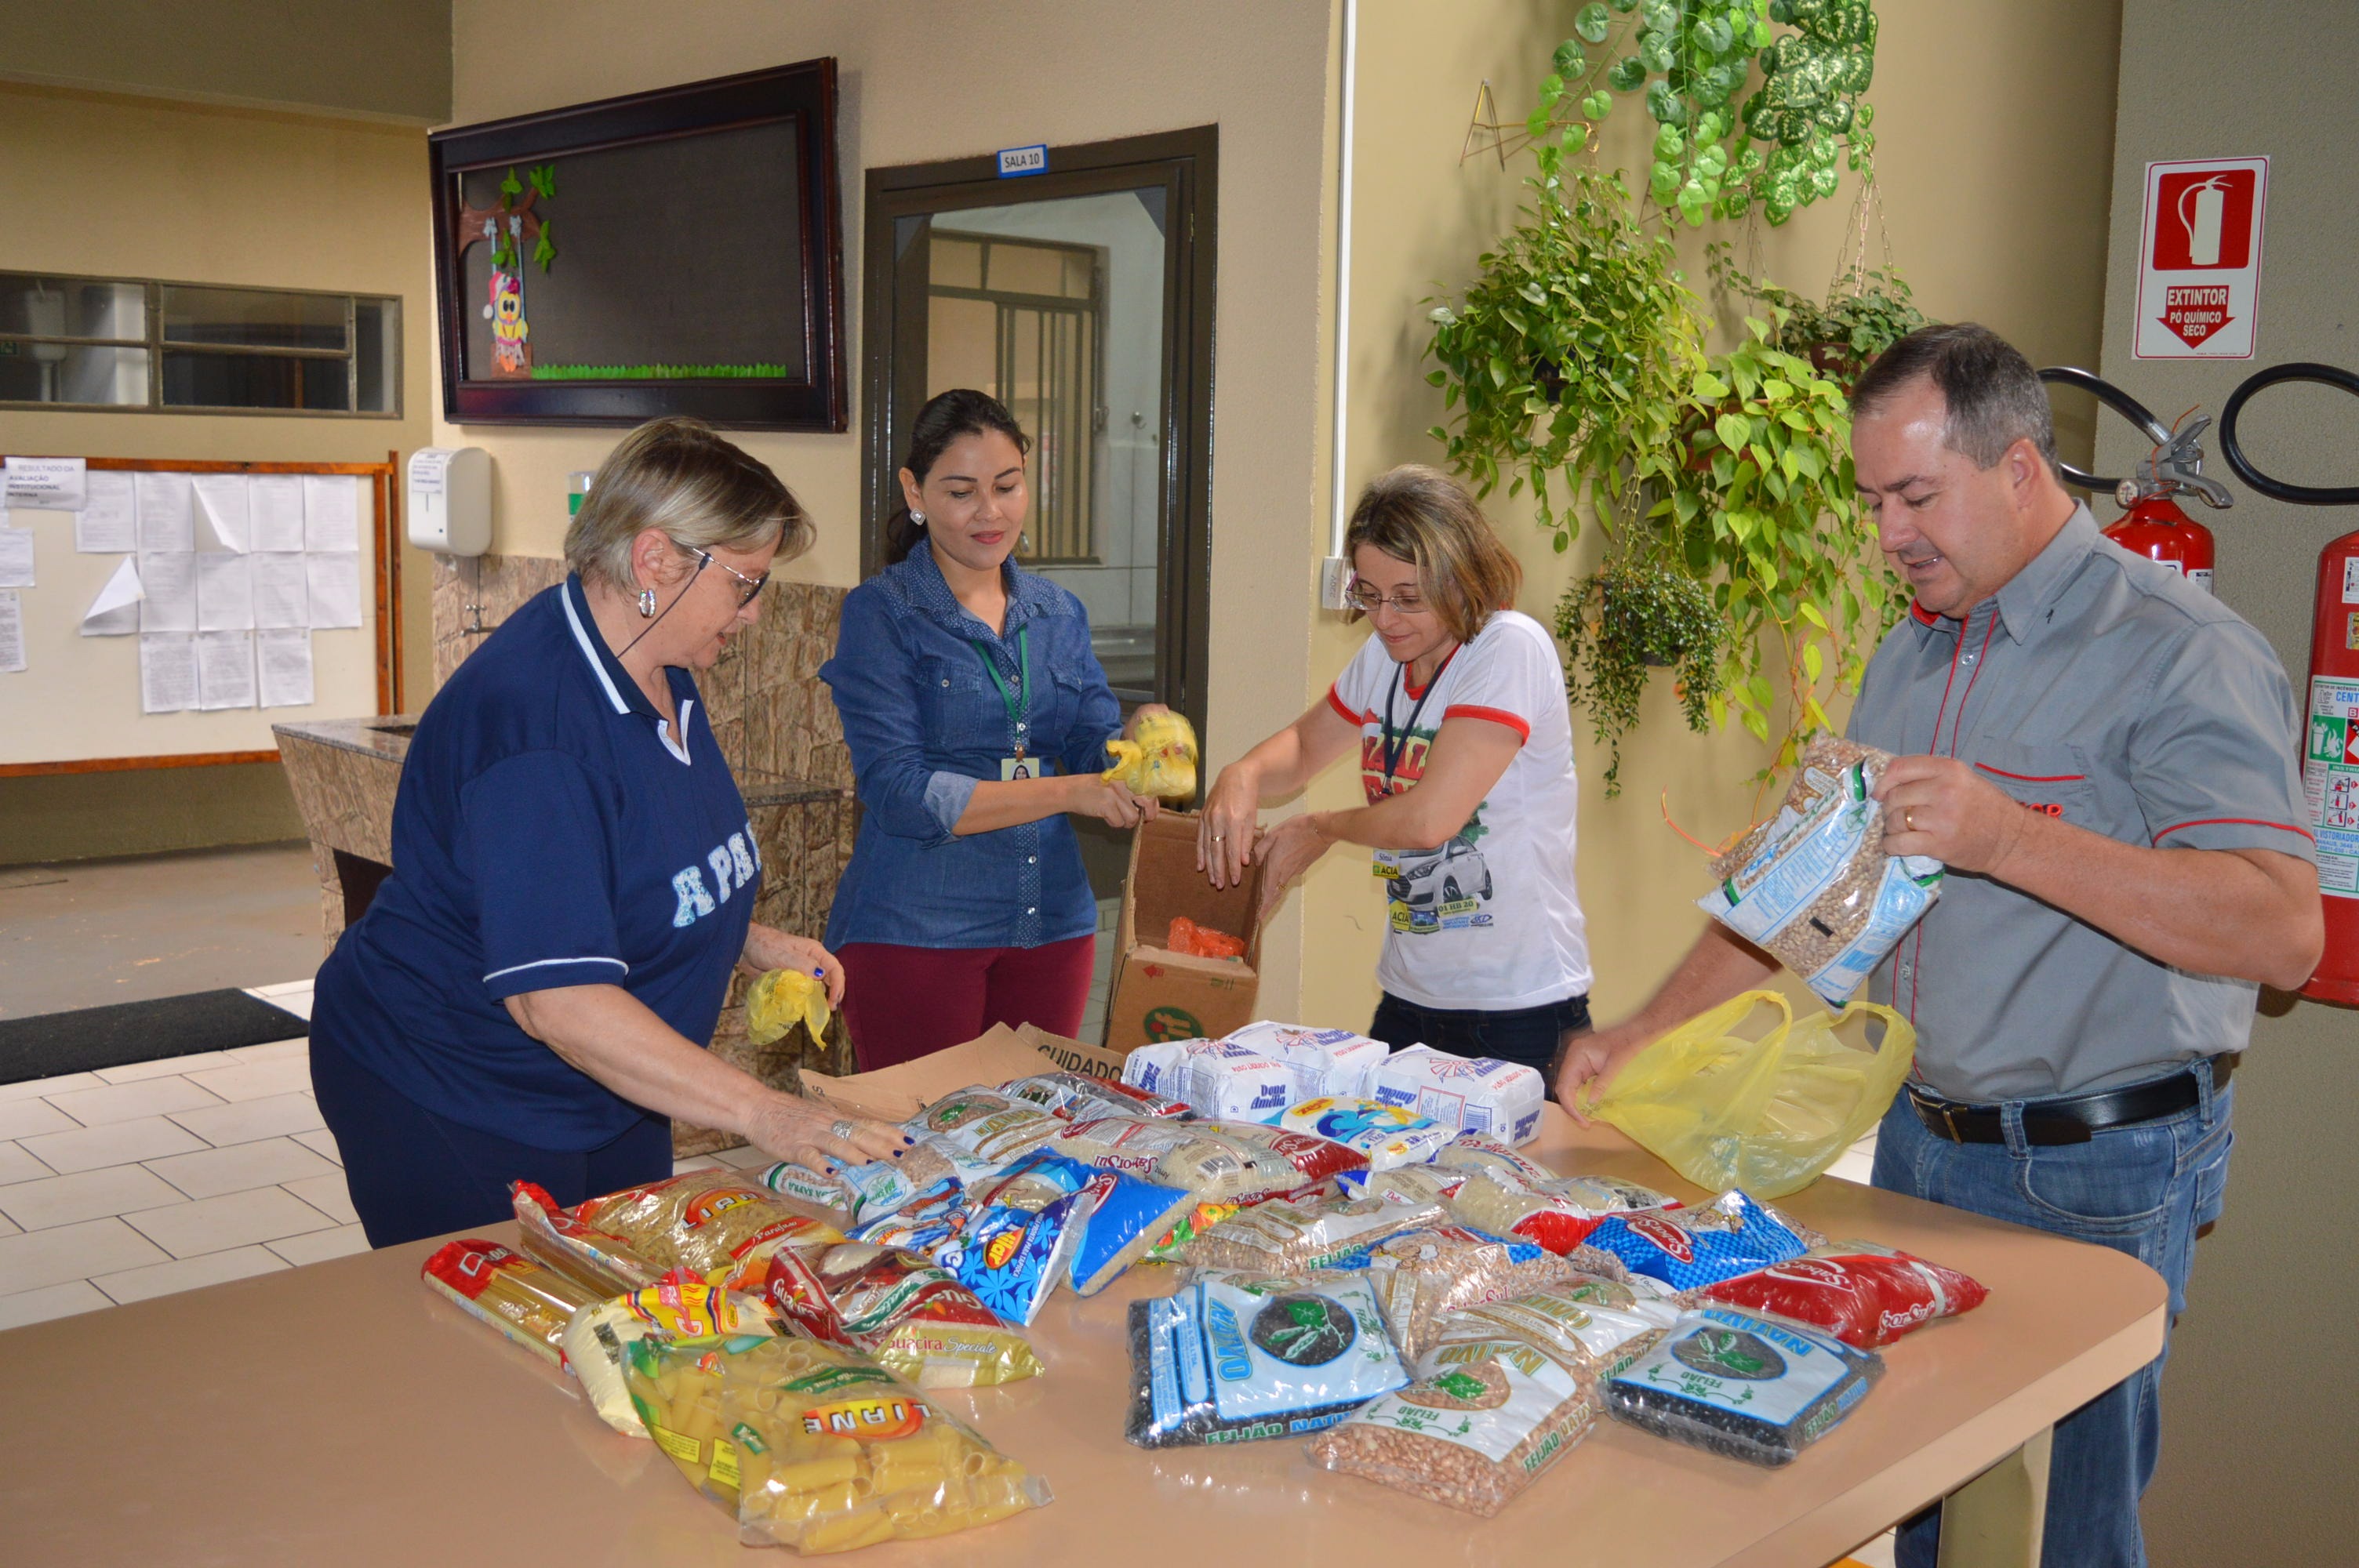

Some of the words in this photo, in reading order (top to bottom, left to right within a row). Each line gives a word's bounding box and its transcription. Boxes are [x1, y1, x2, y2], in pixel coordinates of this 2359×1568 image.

[1005, 155, 1027, 168] SALA
[1029, 153, 1040, 165] 10
[2167, 289, 2227, 307] EXTINTOR
[2170, 310, 2182, 324] PÓ
[2184, 309, 2221, 324] QUÍMICO
[2183, 325, 2207, 336] SECO
[9, 474, 49, 482] AVALIAÇÃO
[1381, 866, 1398, 875] ACIA
[1260, 1084, 1285, 1097] Dona
[1377, 1085, 1417, 1104] Amélia
[1250, 1094, 1285, 1110] Amélia
[1275, 1137, 1314, 1155] borSul
[1093, 1155, 1158, 1174] SaborSul
[1776, 1261, 1851, 1286] SaborS
[1209, 1298, 1253, 1381] NATIVO
[1701, 1308, 1815, 1358] NATIVO
[943, 1336, 998, 1355] Speciale
[1435, 1341, 1547, 1377] NATIVO
[1680, 1371, 1724, 1388] FEIJÃO
[803, 1403, 932, 1434] LIANE
[1398, 1405, 1440, 1421] FEIJÃO
[1205, 1421, 1284, 1445] FEIJÃO
[1521, 1429, 1561, 1474] FEIJÃO
